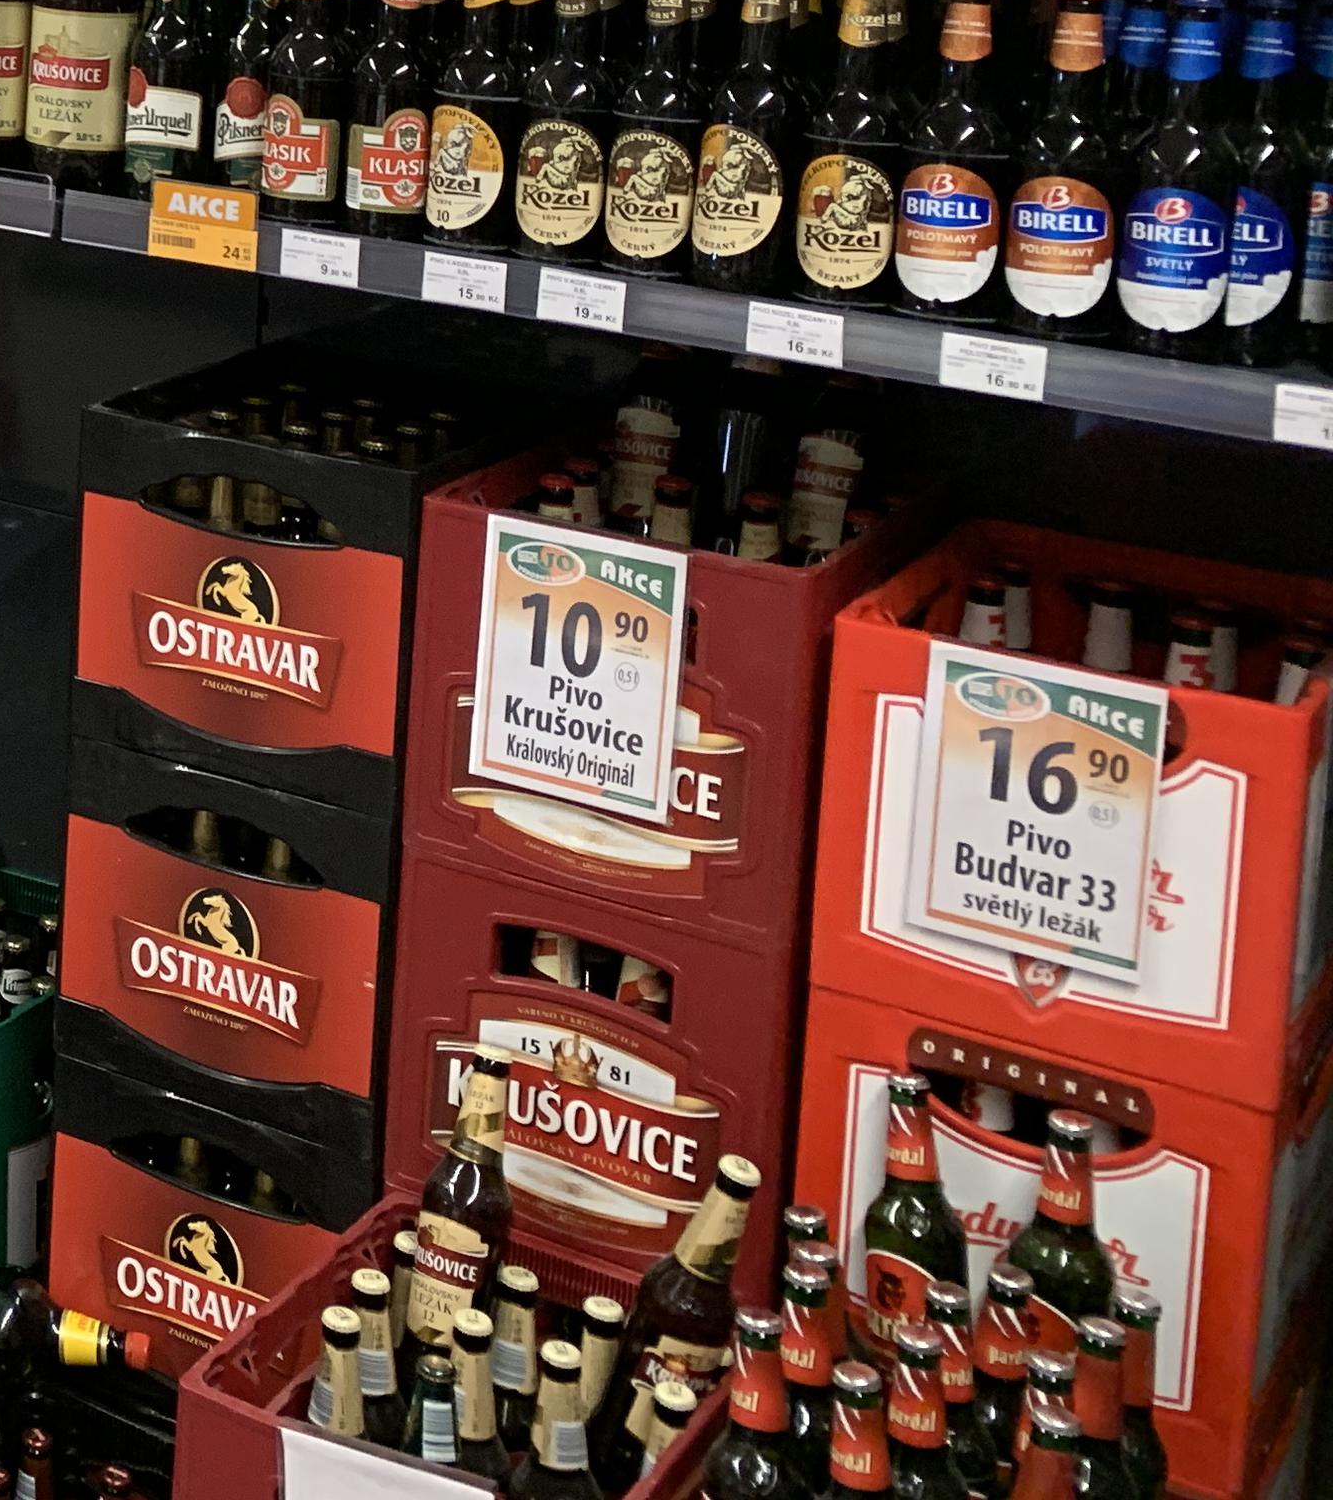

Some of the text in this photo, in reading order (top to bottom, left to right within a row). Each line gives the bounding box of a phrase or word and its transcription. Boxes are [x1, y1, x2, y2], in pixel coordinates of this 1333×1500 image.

[749, 5, 762, 18] 11
[857, 29, 870, 42] 11
[38, 106, 83, 124] LEŽÁK
[167, 191, 240, 222] AKCE
[522, 184, 590, 213] Kozel
[611, 194, 679, 225] Kozel
[694, 195, 759, 222] Kozel
[906, 196, 982, 221] BIRELL
[436, 208, 450, 223] 10
[1017, 209, 1100, 234] BIRELL
[804, 223, 881, 252] Kozel
[906, 228, 978, 245] POLOTMAVÝ
[1131, 220, 1214, 247] BIRELL
[222, 245, 240, 260] 24
[1019, 242, 1095, 259] POLOTMAVÝ
[320, 262, 328, 276] 9
[817, 269, 861, 284] ŘEZANÝ
[458, 287, 474, 300] 15
[574, 305, 590, 319] 19
[786, 339, 804, 354] 16
[985, 373, 1005, 388] 16
[600, 558, 663, 599] AKCE
[521, 591, 649, 679] 10 90
[148, 610, 322, 693] OSTRAVAR
[548, 674, 603, 711] Pivo
[503, 694, 644, 757] Krušovice
[1067, 694, 1146, 740] AKCE
[506, 733, 635, 788] Královský Originál
[978, 725, 1130, 816] 16 90
[1006, 819, 1073, 861] Pivo
[954, 841, 1117, 913] Budvar 33
[962, 892, 1102, 944] světlý ležák
[129, 935, 300, 1031] OSTRAVAR
[518, 1035, 632, 1086] 15 81
[921, 1039, 1142, 1115] ORIGINAL
[447, 1058, 698, 1183] KUŠOVICE
[424, 1310, 434, 1323] 12
